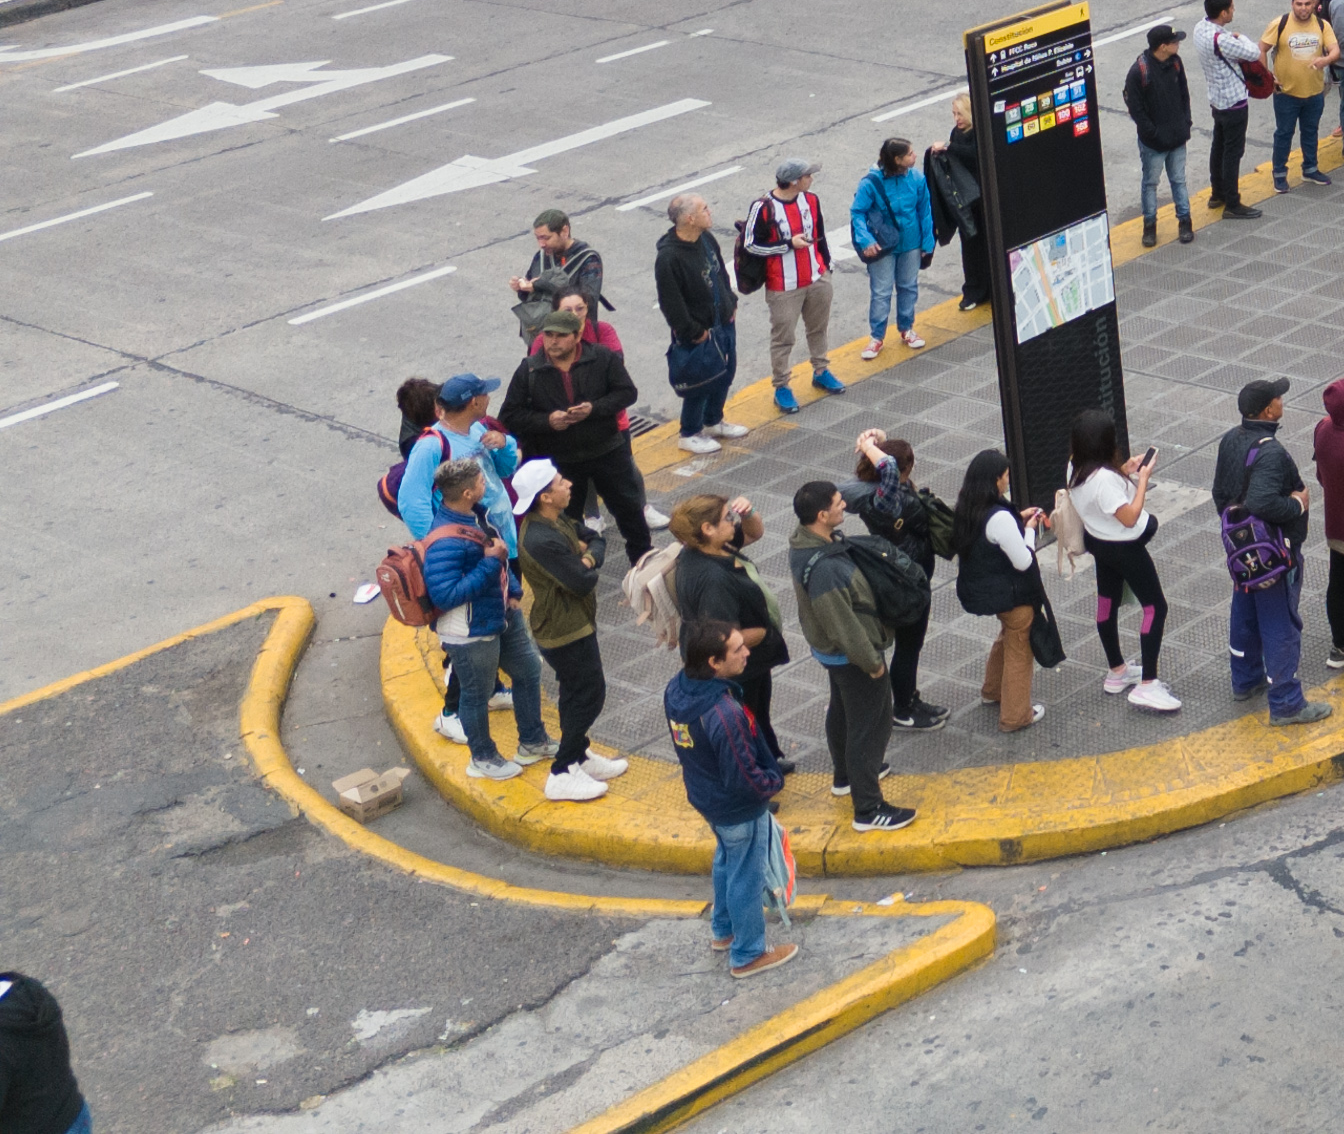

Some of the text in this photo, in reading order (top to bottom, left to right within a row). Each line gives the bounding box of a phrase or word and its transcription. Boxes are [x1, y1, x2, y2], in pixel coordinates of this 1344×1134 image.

[989, 26, 1034, 46] Constitución
[1001, 58, 1024, 73] Hospital
[1092, 315, 1117, 423] stitución
